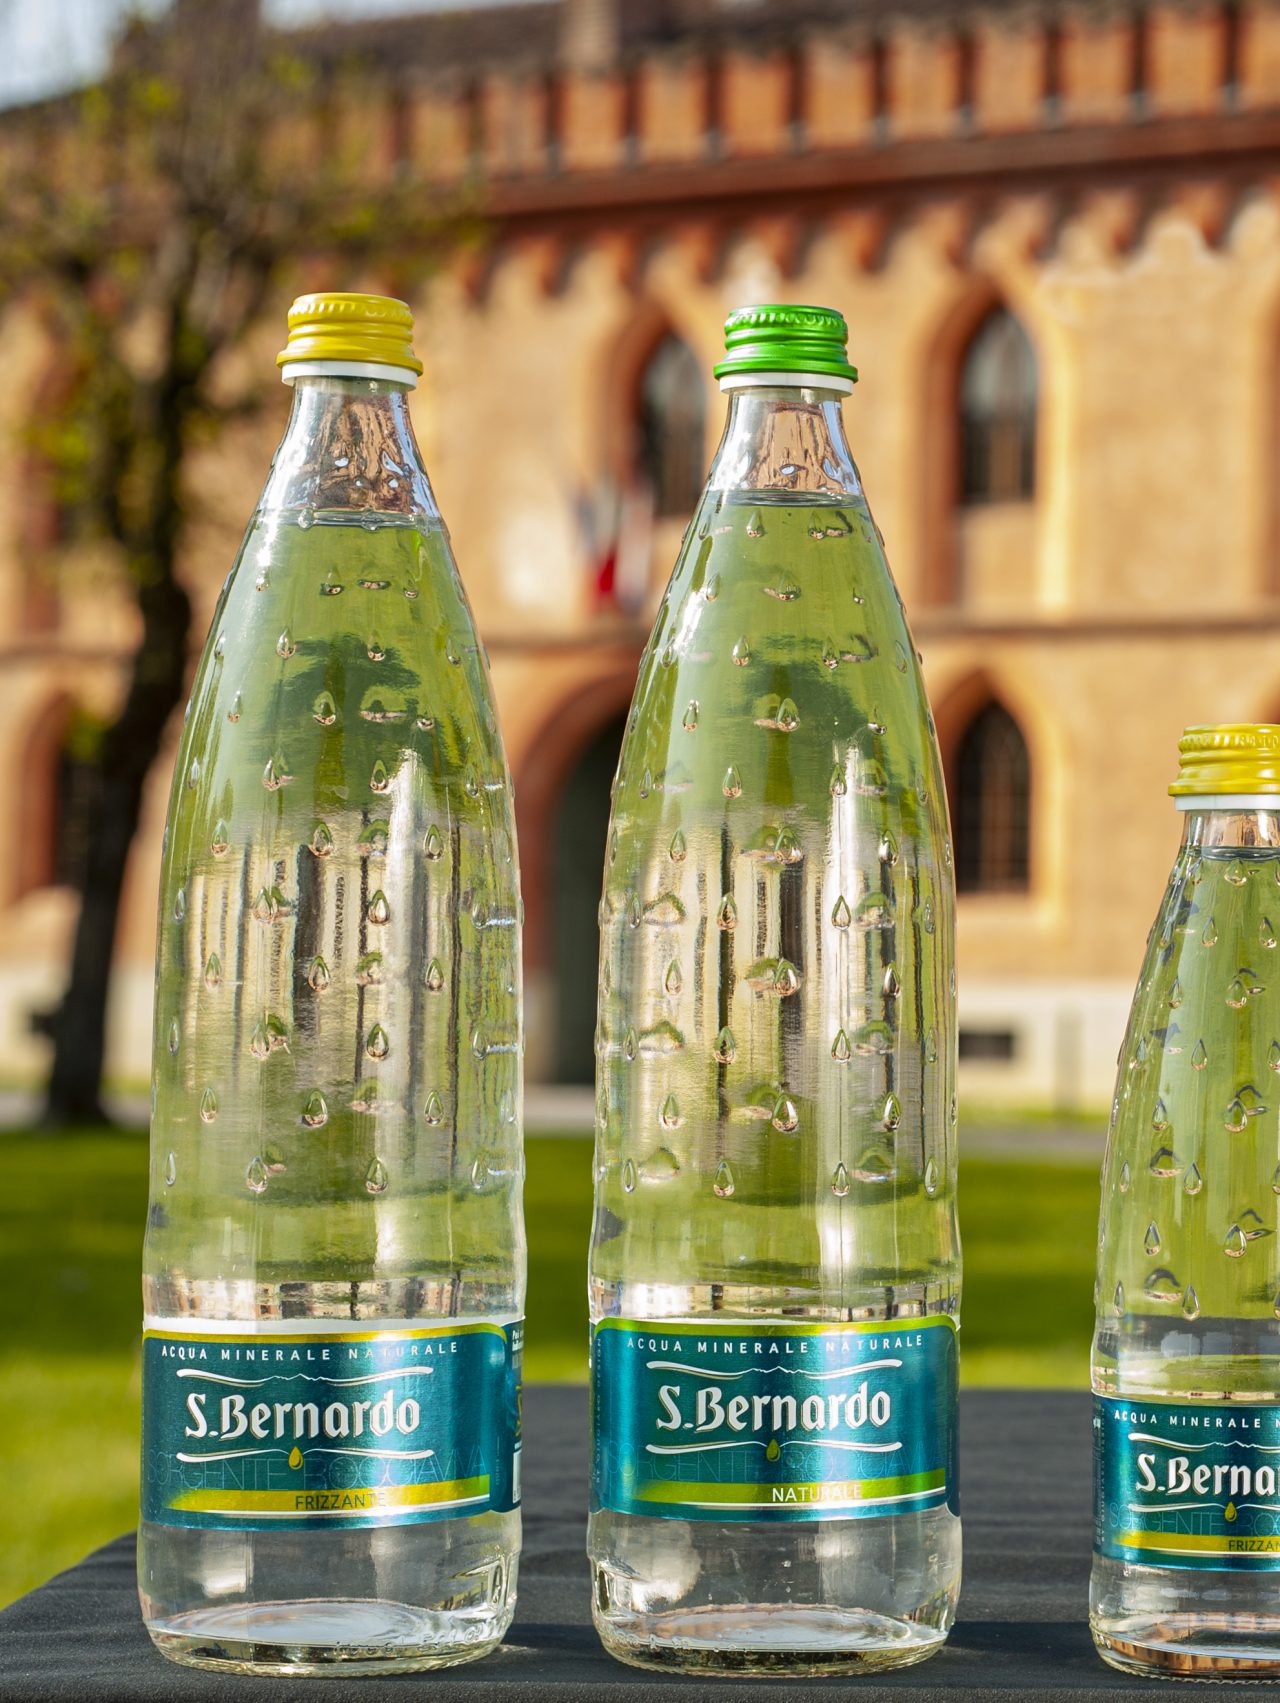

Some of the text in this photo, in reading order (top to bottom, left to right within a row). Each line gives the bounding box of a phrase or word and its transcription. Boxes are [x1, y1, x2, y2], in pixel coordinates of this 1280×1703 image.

[161, 1342, 458, 1361] ACQUA MINERALE NATURALE
[627, 1334, 923, 1354] ACQUA MINERALE NATURALE
[185, 1391, 421, 1441] S.Bernardo
[655, 1381, 891, 1434] S.Bernardo
[1114, 1409, 1157, 1424] ACQUA
[1170, 1416, 1261, 1428] MINERALE
[295, 1492, 387, 1511] FRIZZANTE
[772, 1484, 862, 1502] NATURALE
